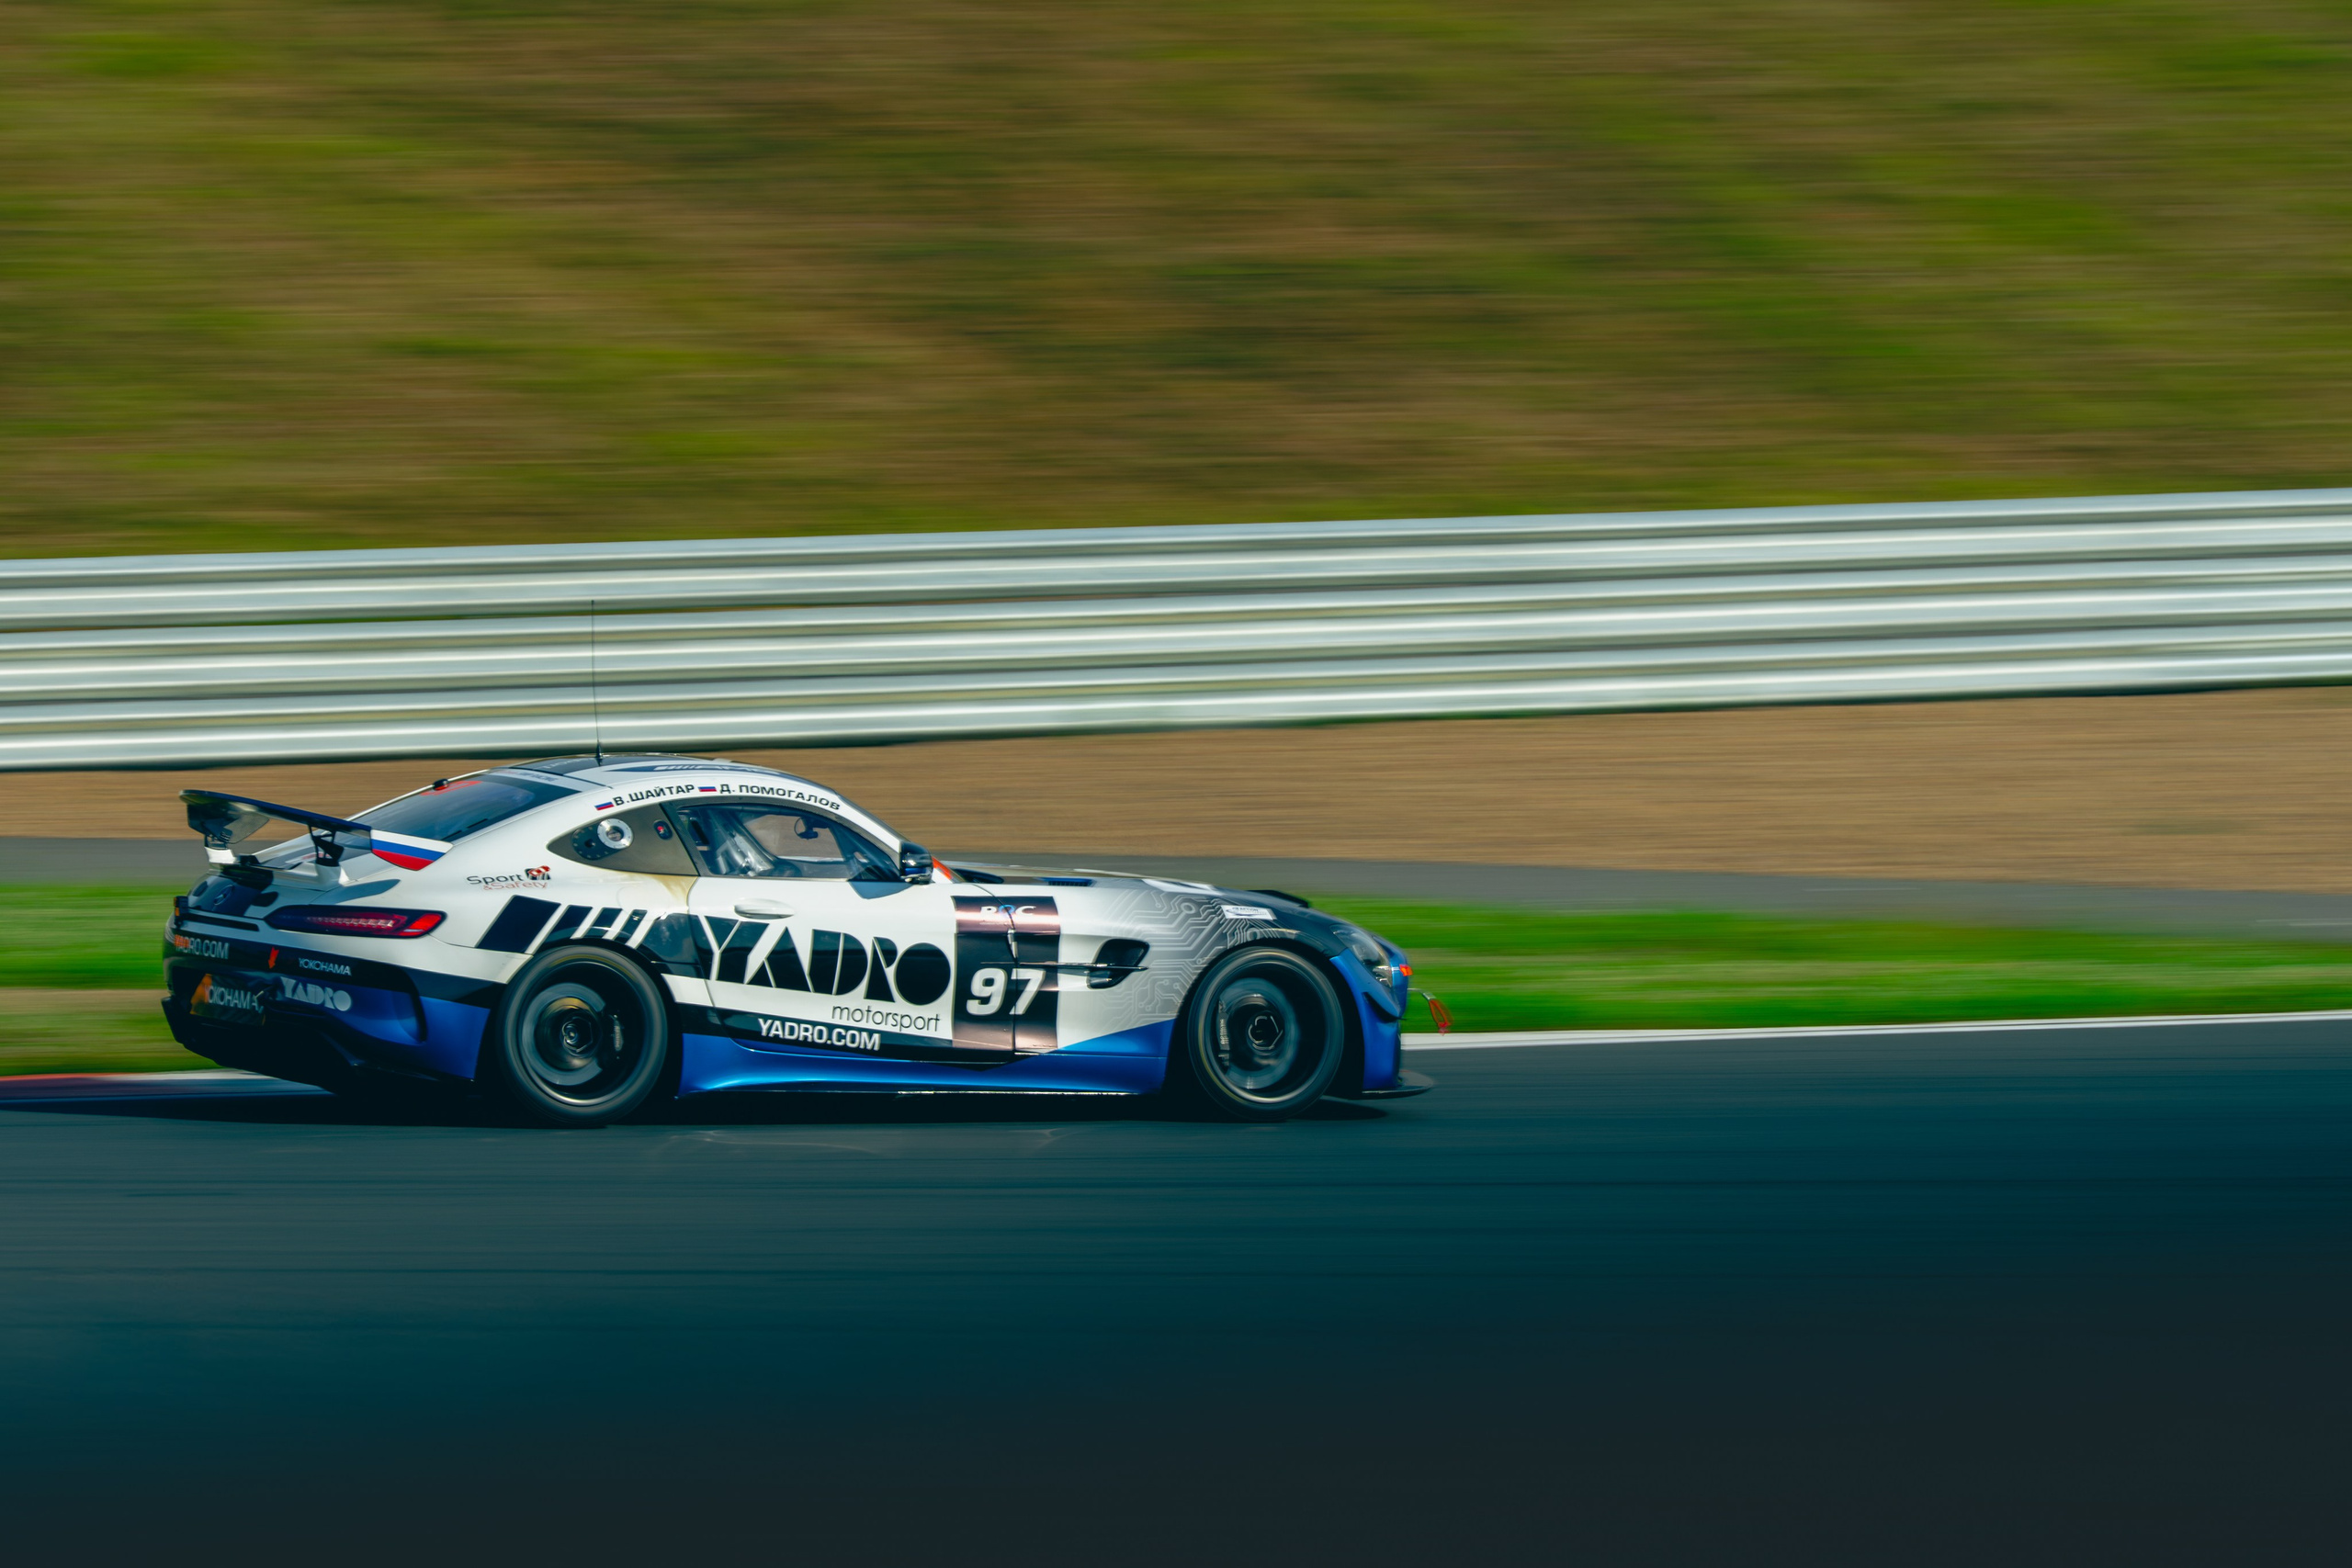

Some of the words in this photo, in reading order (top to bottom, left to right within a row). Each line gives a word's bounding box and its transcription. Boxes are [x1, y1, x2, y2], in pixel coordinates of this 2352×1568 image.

[612, 784, 695, 807] В.ШАЙТАР
[739, 784, 841, 811] ПОМОГАЛОВ
[466, 874, 524, 886] Sport
[298, 957, 353, 976] YOKOHAMA
[704, 915, 952, 1006] YADRO
[204, 984, 264, 1013] YOKOHAMA
[280, 976, 353, 1011] YADRO
[966, 967, 1046, 1016] 97
[831, 1005, 942, 1032] motorsport
[757, 1017, 882, 1052] YADRO.COM
